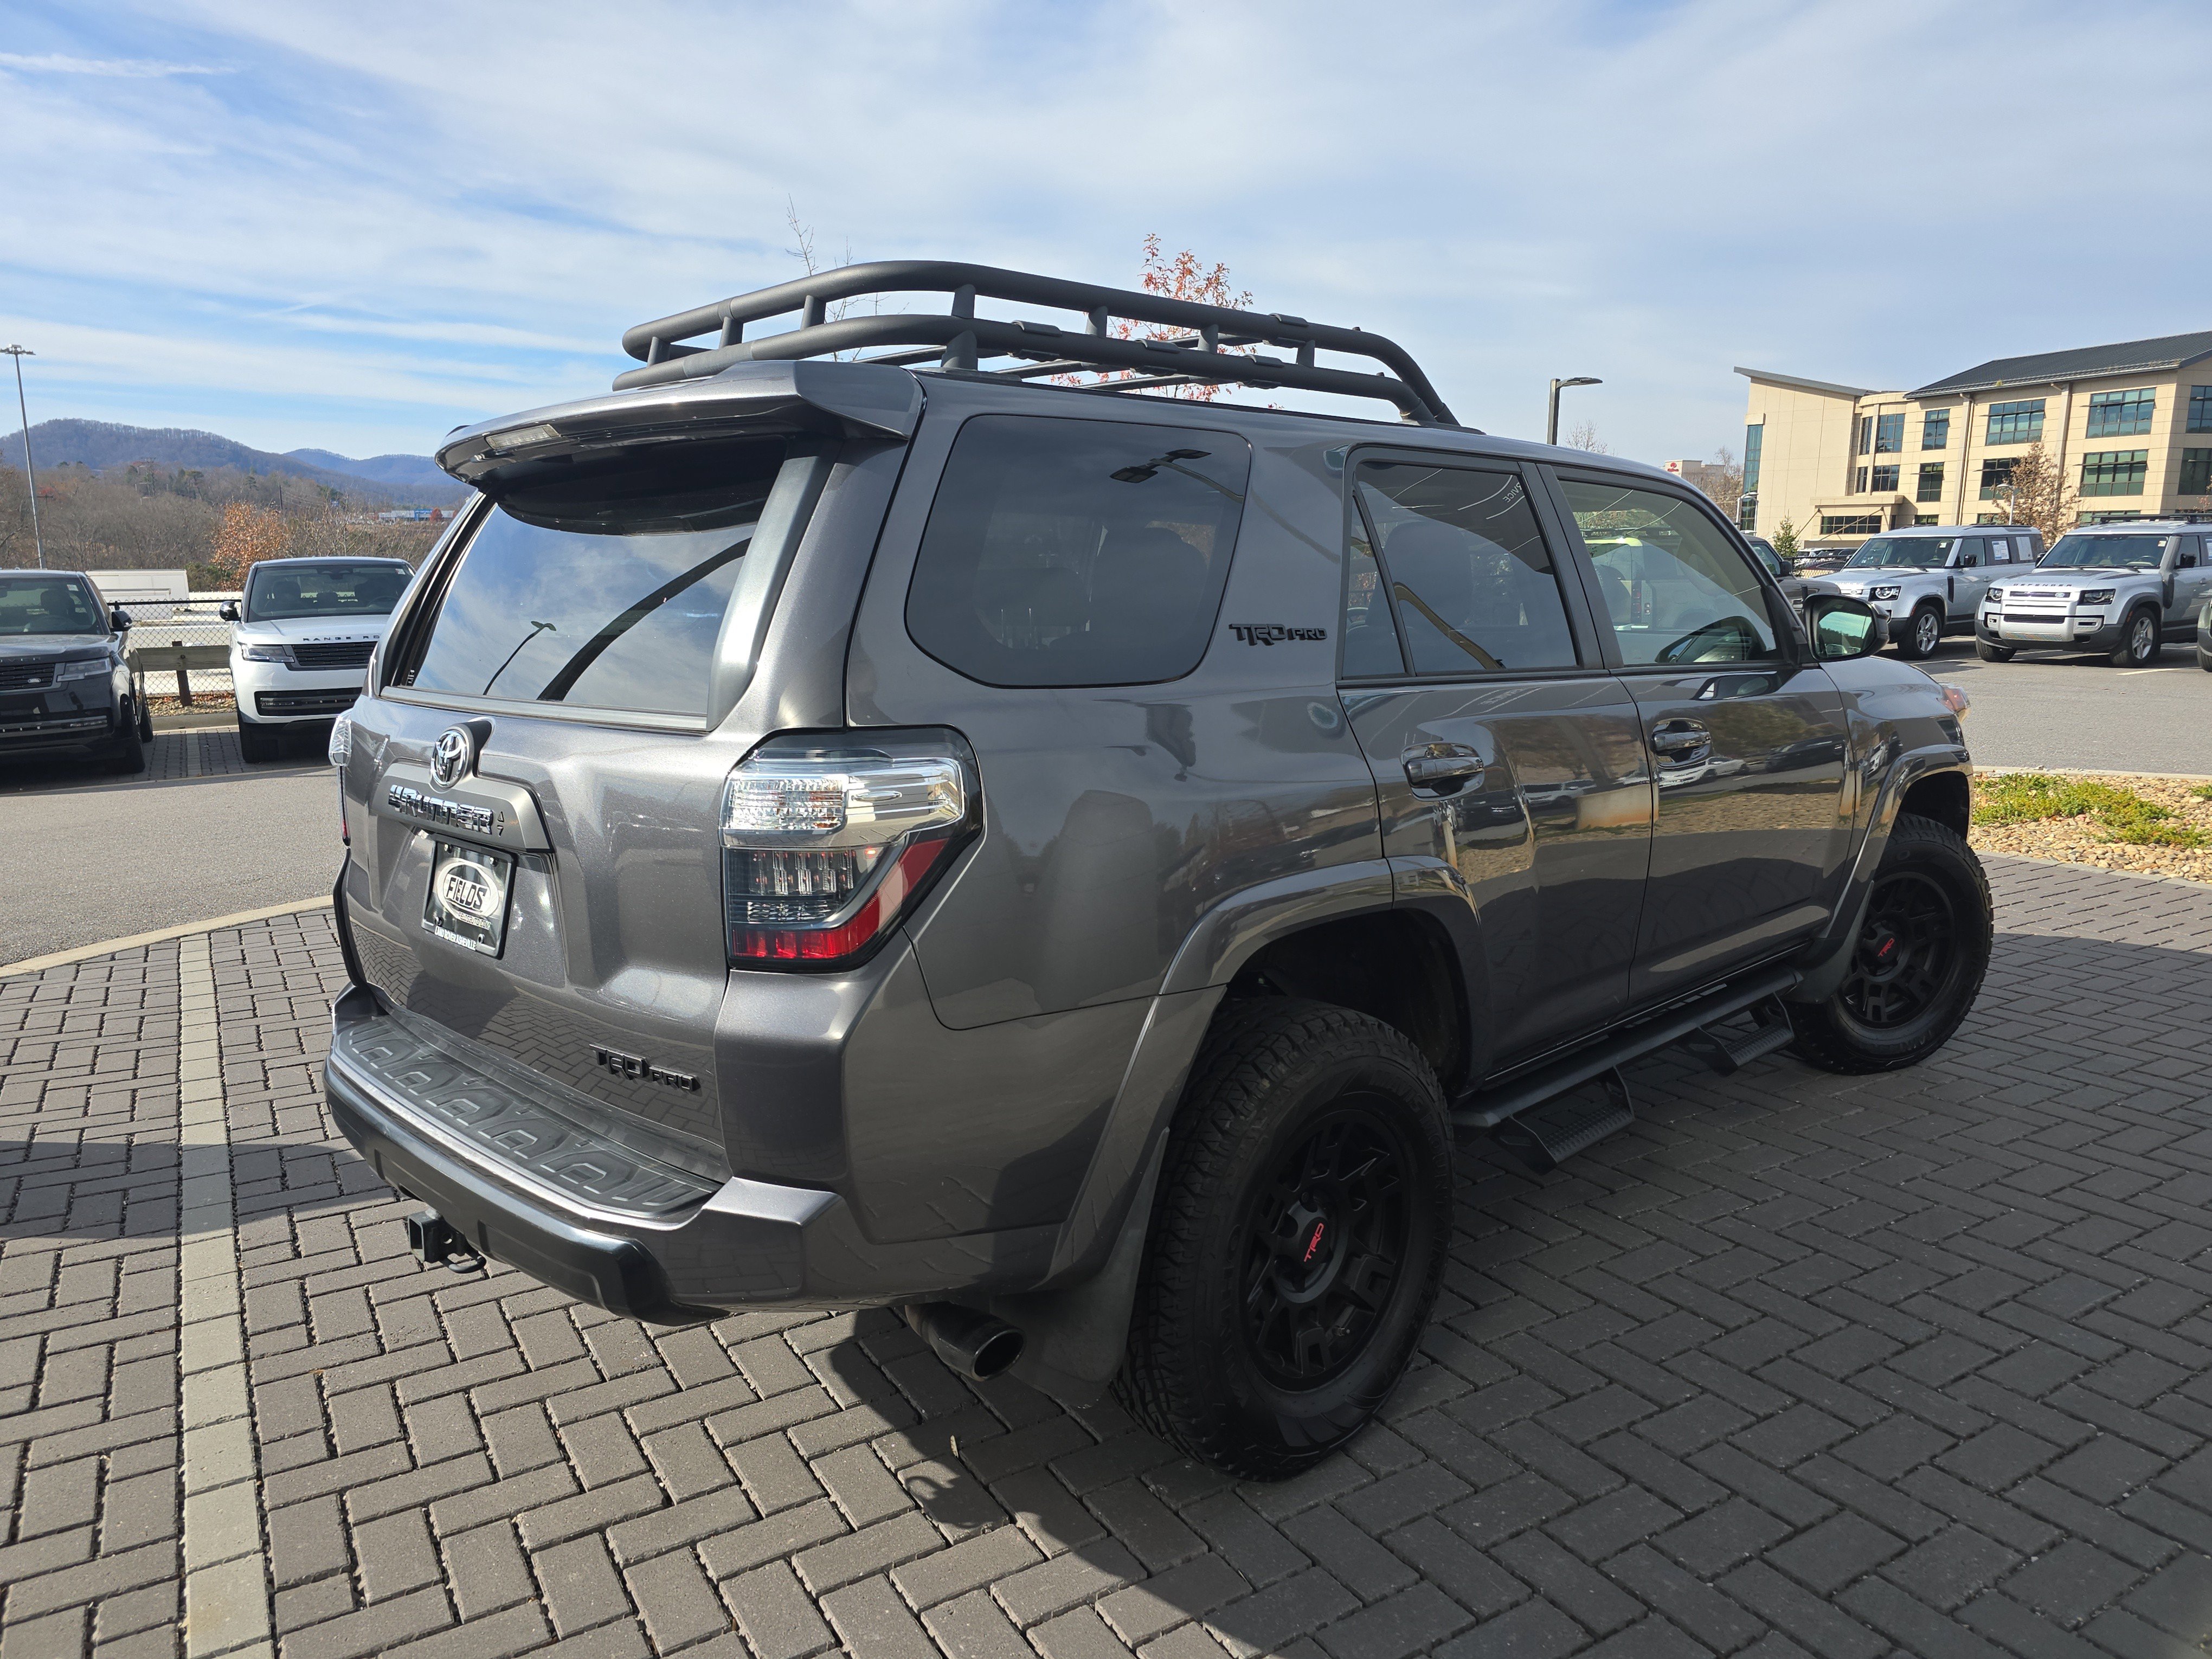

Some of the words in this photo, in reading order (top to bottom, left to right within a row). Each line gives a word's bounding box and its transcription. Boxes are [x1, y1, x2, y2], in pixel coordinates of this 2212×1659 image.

[1229, 623, 1287, 646] TRD
[1287, 628, 1328, 641] PRO
[446, 877, 487, 909] FIELDS
[1877, 938, 1895, 957] TRD
[589, 1044, 650, 1080] TRD
[649, 1065, 701, 1092] PRO
[1303, 1223, 1324, 1262] TRD
